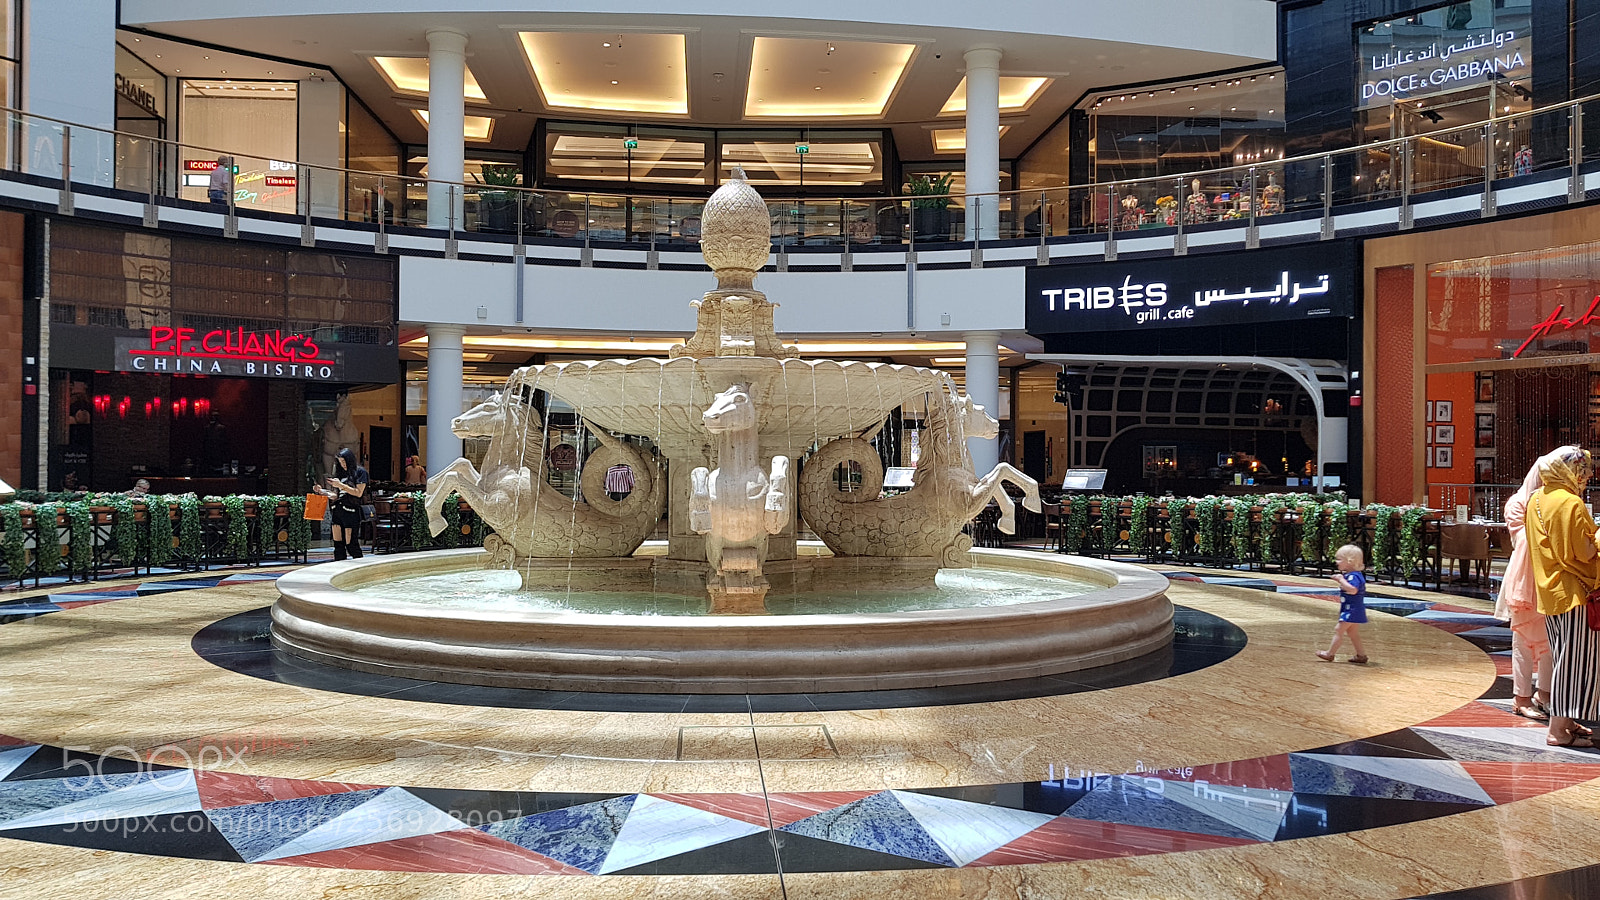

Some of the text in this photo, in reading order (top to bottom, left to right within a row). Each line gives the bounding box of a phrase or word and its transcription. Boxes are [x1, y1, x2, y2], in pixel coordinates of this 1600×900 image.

[1372, 29, 1515, 71] دولتشي اند غابانا
[115, 73, 158, 114] CHANEL
[1362, 52, 1525, 99] DOLCE & GABBANA
[190, 161, 217, 169] ICONIC
[266, 177, 297, 185] Timeless
[1041, 274, 1168, 315] TRIBES
[1194, 271, 1329, 307] ترايبس
[1136, 308, 1160, 324] grill
[151, 326, 320, 362] P.F. CHANG'S
[133, 356, 332, 378] CHINA BISTRO
